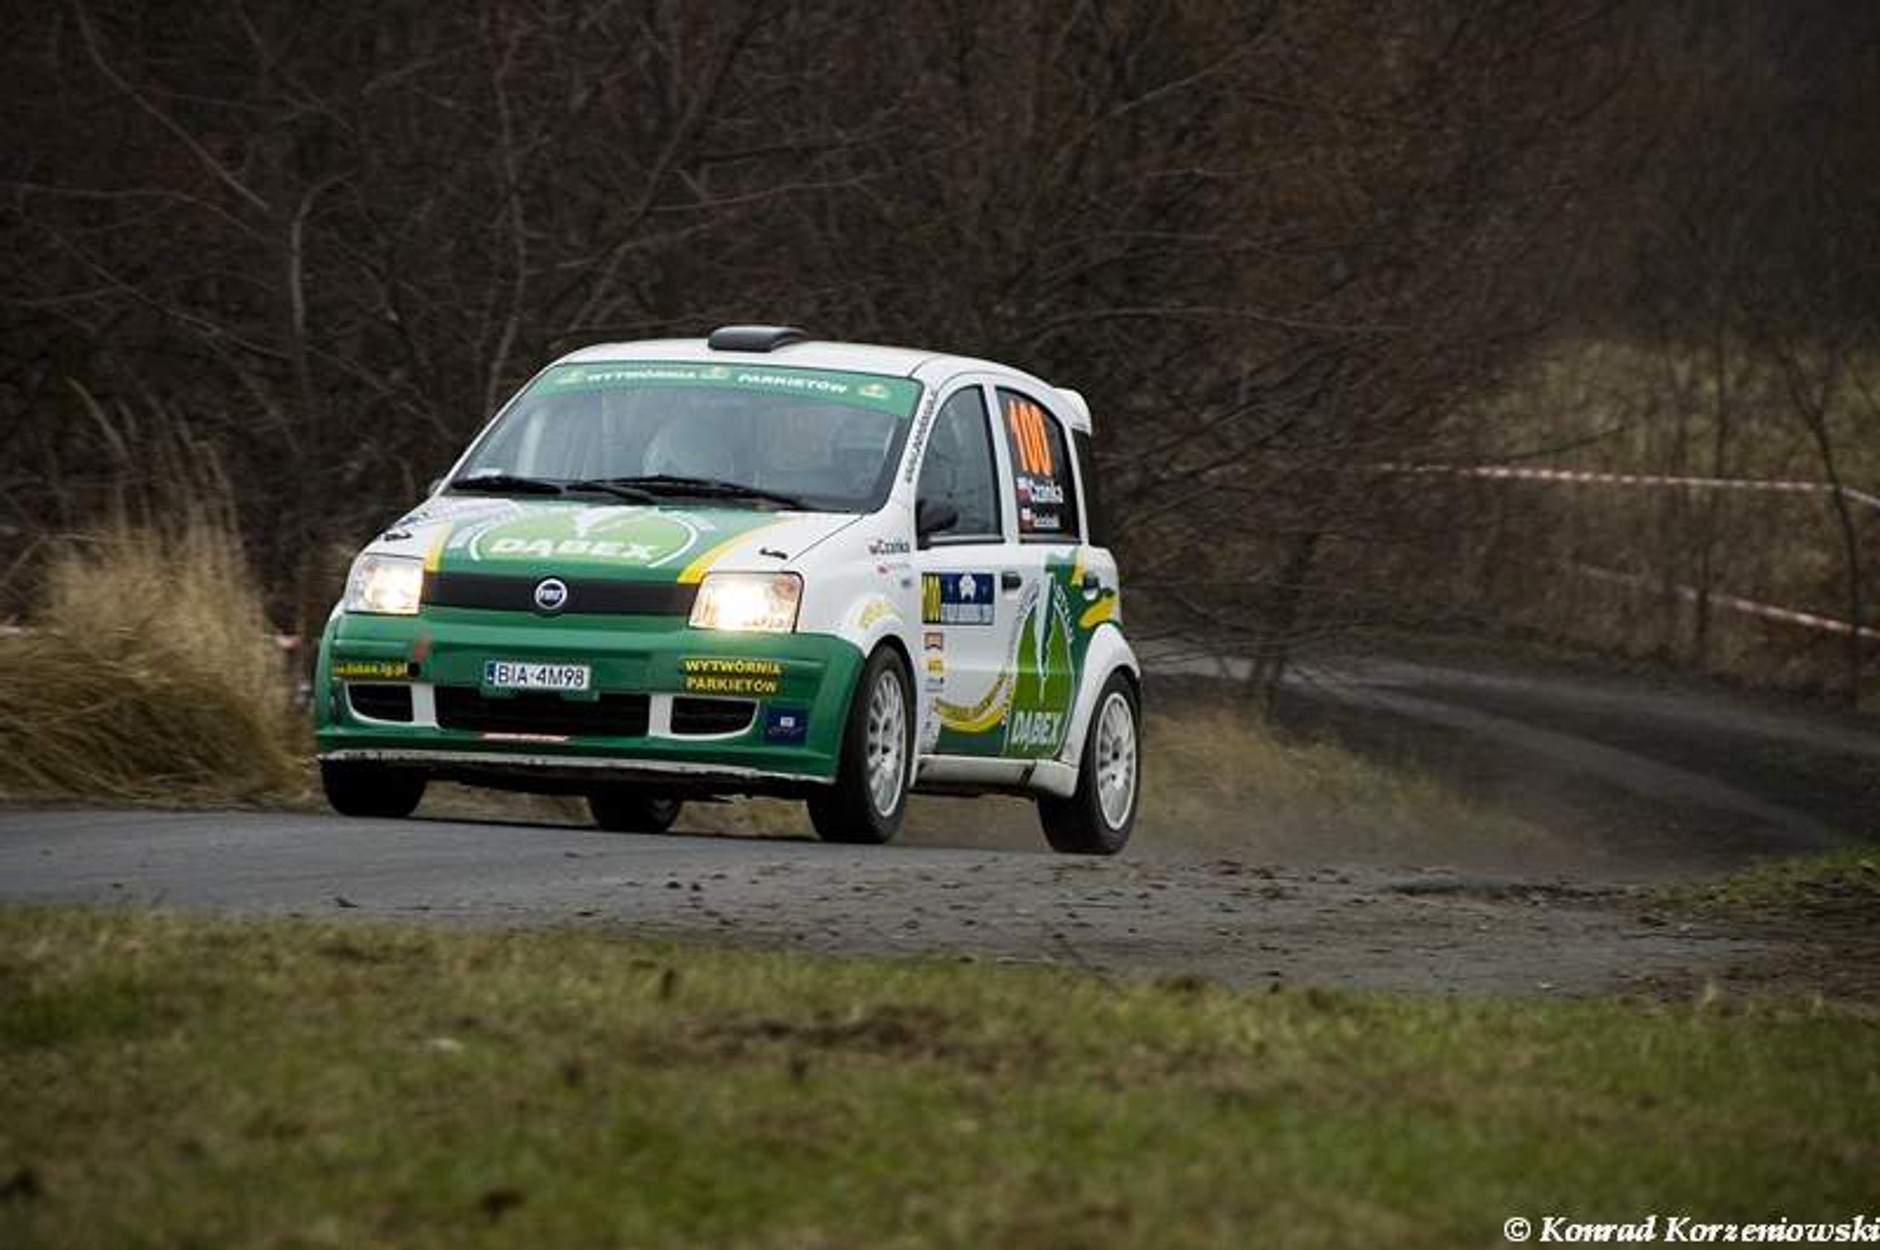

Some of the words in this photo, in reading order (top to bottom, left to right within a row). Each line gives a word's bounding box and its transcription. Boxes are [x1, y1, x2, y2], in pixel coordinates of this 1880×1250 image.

[738, 374, 847, 393] PARKIETÓW
[1009, 400, 1053, 476] 100
[685, 659, 782, 675] WYTWÓRNIA
[686, 677, 777, 693] PARKIETÓW
